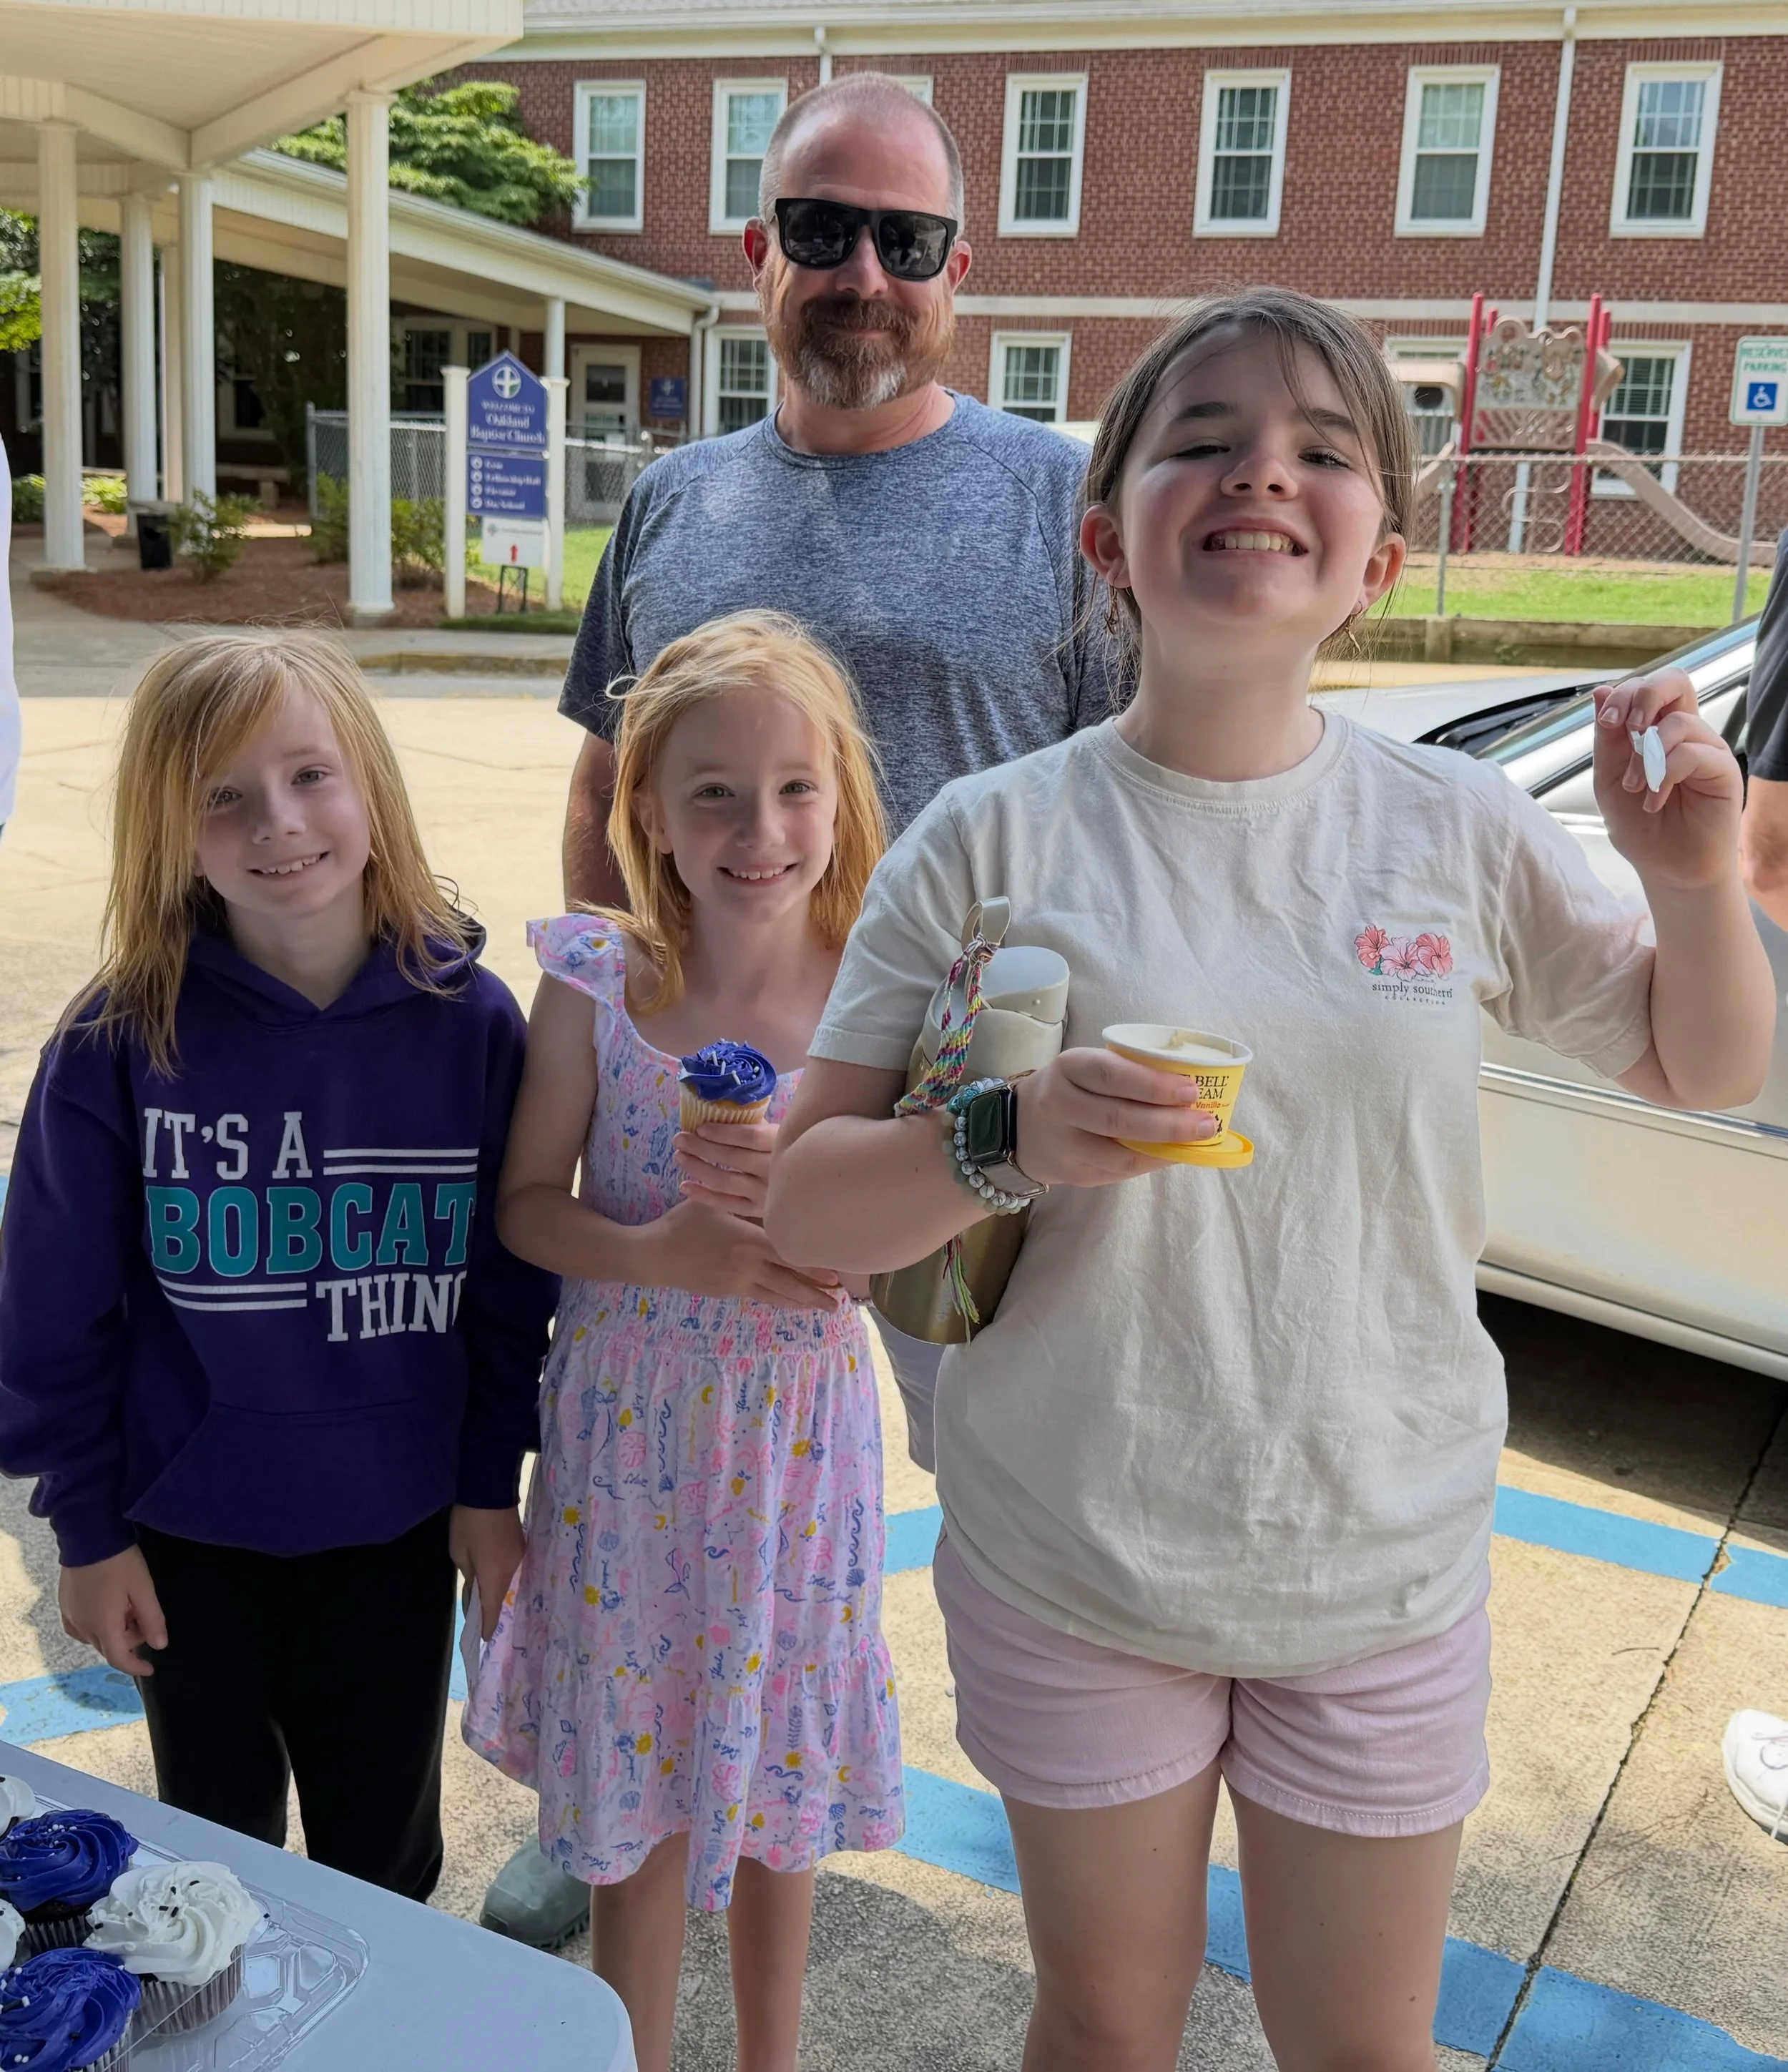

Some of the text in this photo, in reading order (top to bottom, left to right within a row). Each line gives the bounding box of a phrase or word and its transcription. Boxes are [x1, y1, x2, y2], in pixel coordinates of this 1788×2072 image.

[1372, 981, 1453, 998] simply southern
[1199, 1087, 1224, 1099] EAM
[144, 1108, 313, 1180] IT'S A
[146, 1181, 477, 1277] BOBCAT
